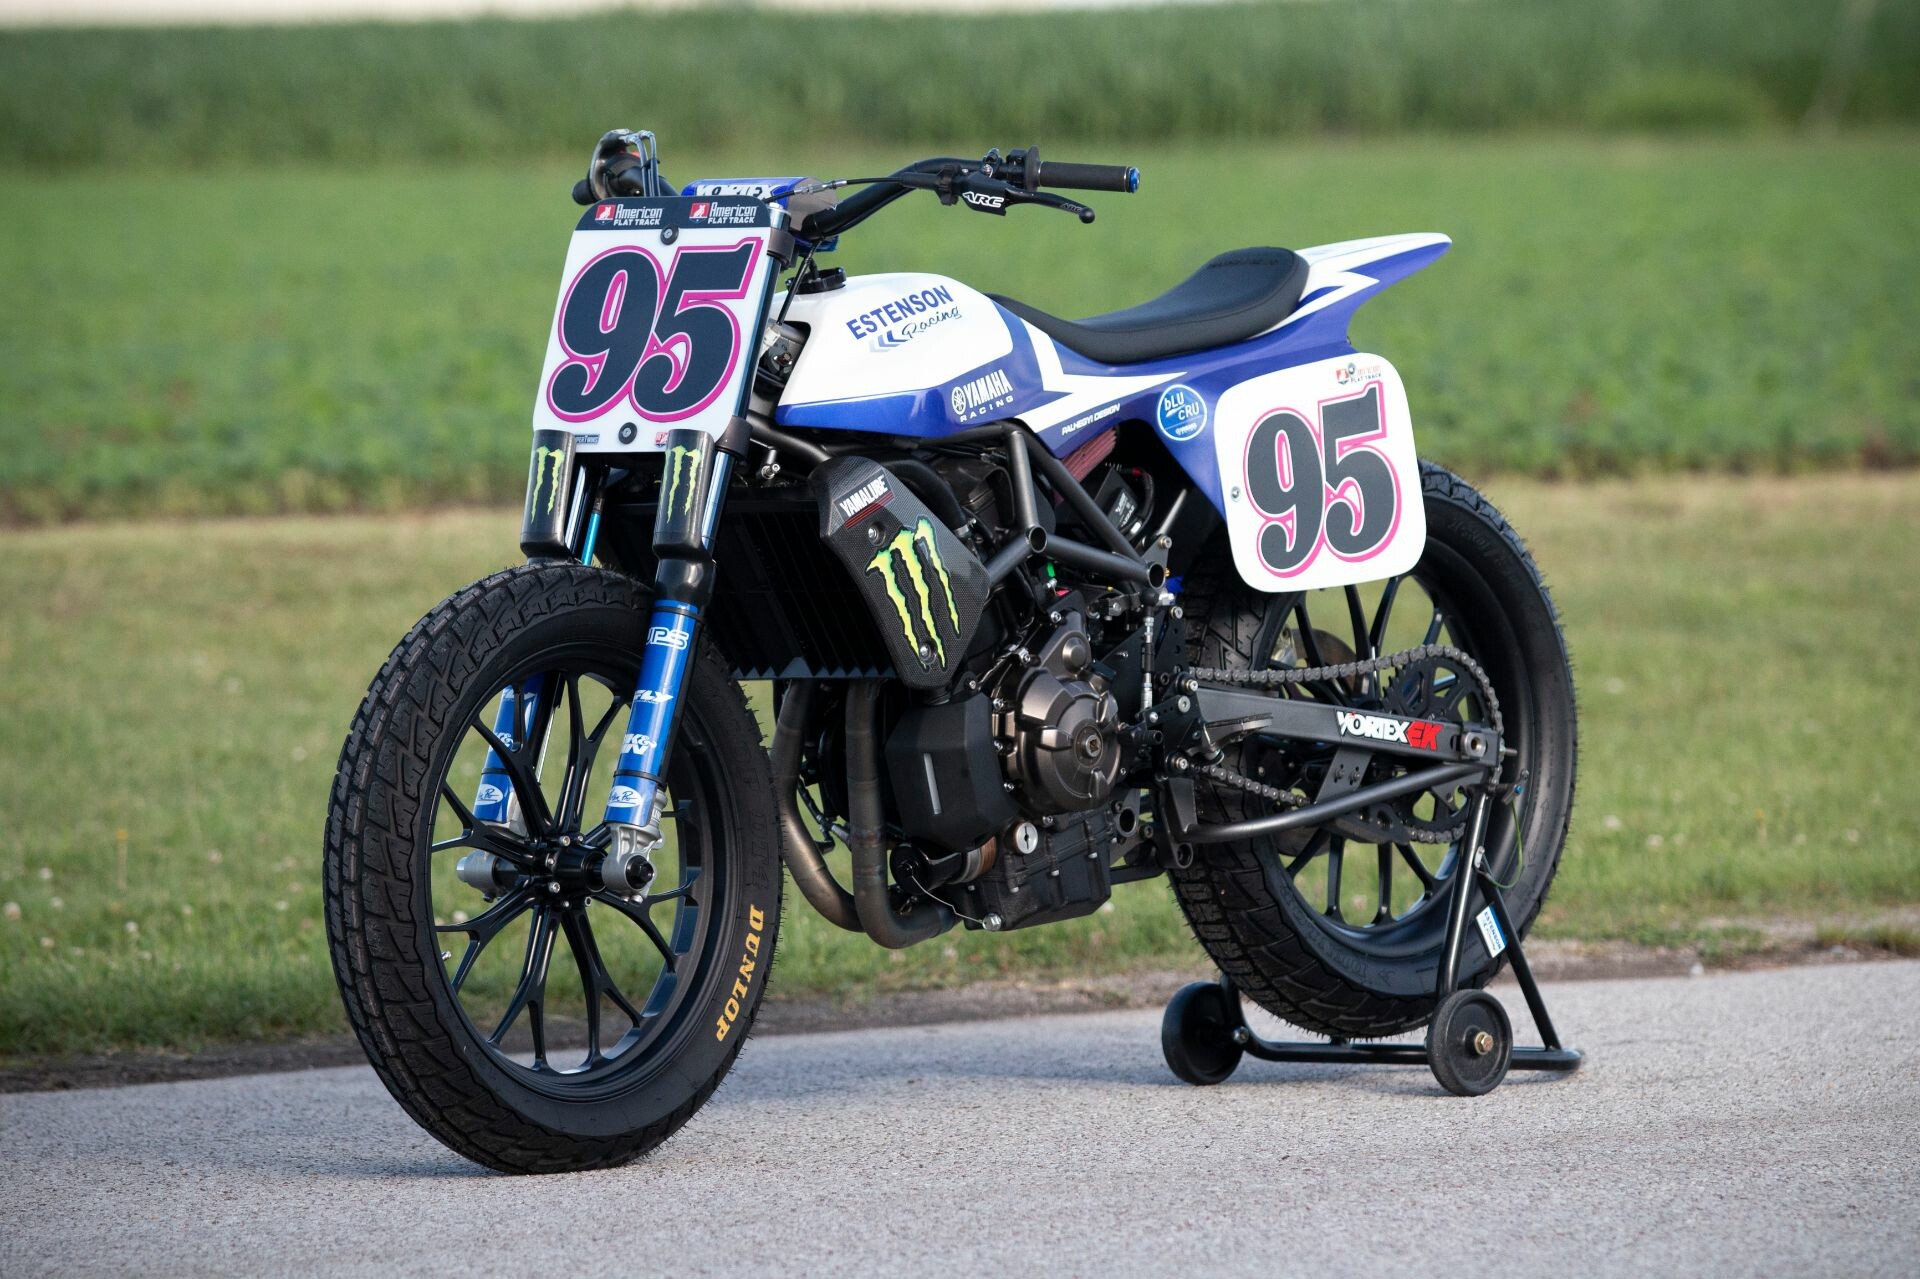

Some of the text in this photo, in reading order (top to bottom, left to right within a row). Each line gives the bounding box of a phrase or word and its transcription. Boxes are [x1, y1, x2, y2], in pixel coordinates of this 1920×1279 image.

[615, 203, 663, 219] American
[710, 201, 758, 217] American
[962, 191, 1004, 208] ARC
[613, 218, 660, 226] FLAT TRACK
[707, 216, 755, 225] FLAT TRACK
[846, 285, 954, 340] ESTENSON
[901, 306, 962, 339] Racing
[546, 237, 763, 423] 95
[963, 369, 1013, 409] YAMAHA
[960, 396, 1014, 423] RACING
[1243, 380, 1402, 578] 95
[839, 474, 890, 517] YAMALUBE
[1336, 711, 1410, 743] VORTEX
[715, 904, 764, 1042] DUNLOP
